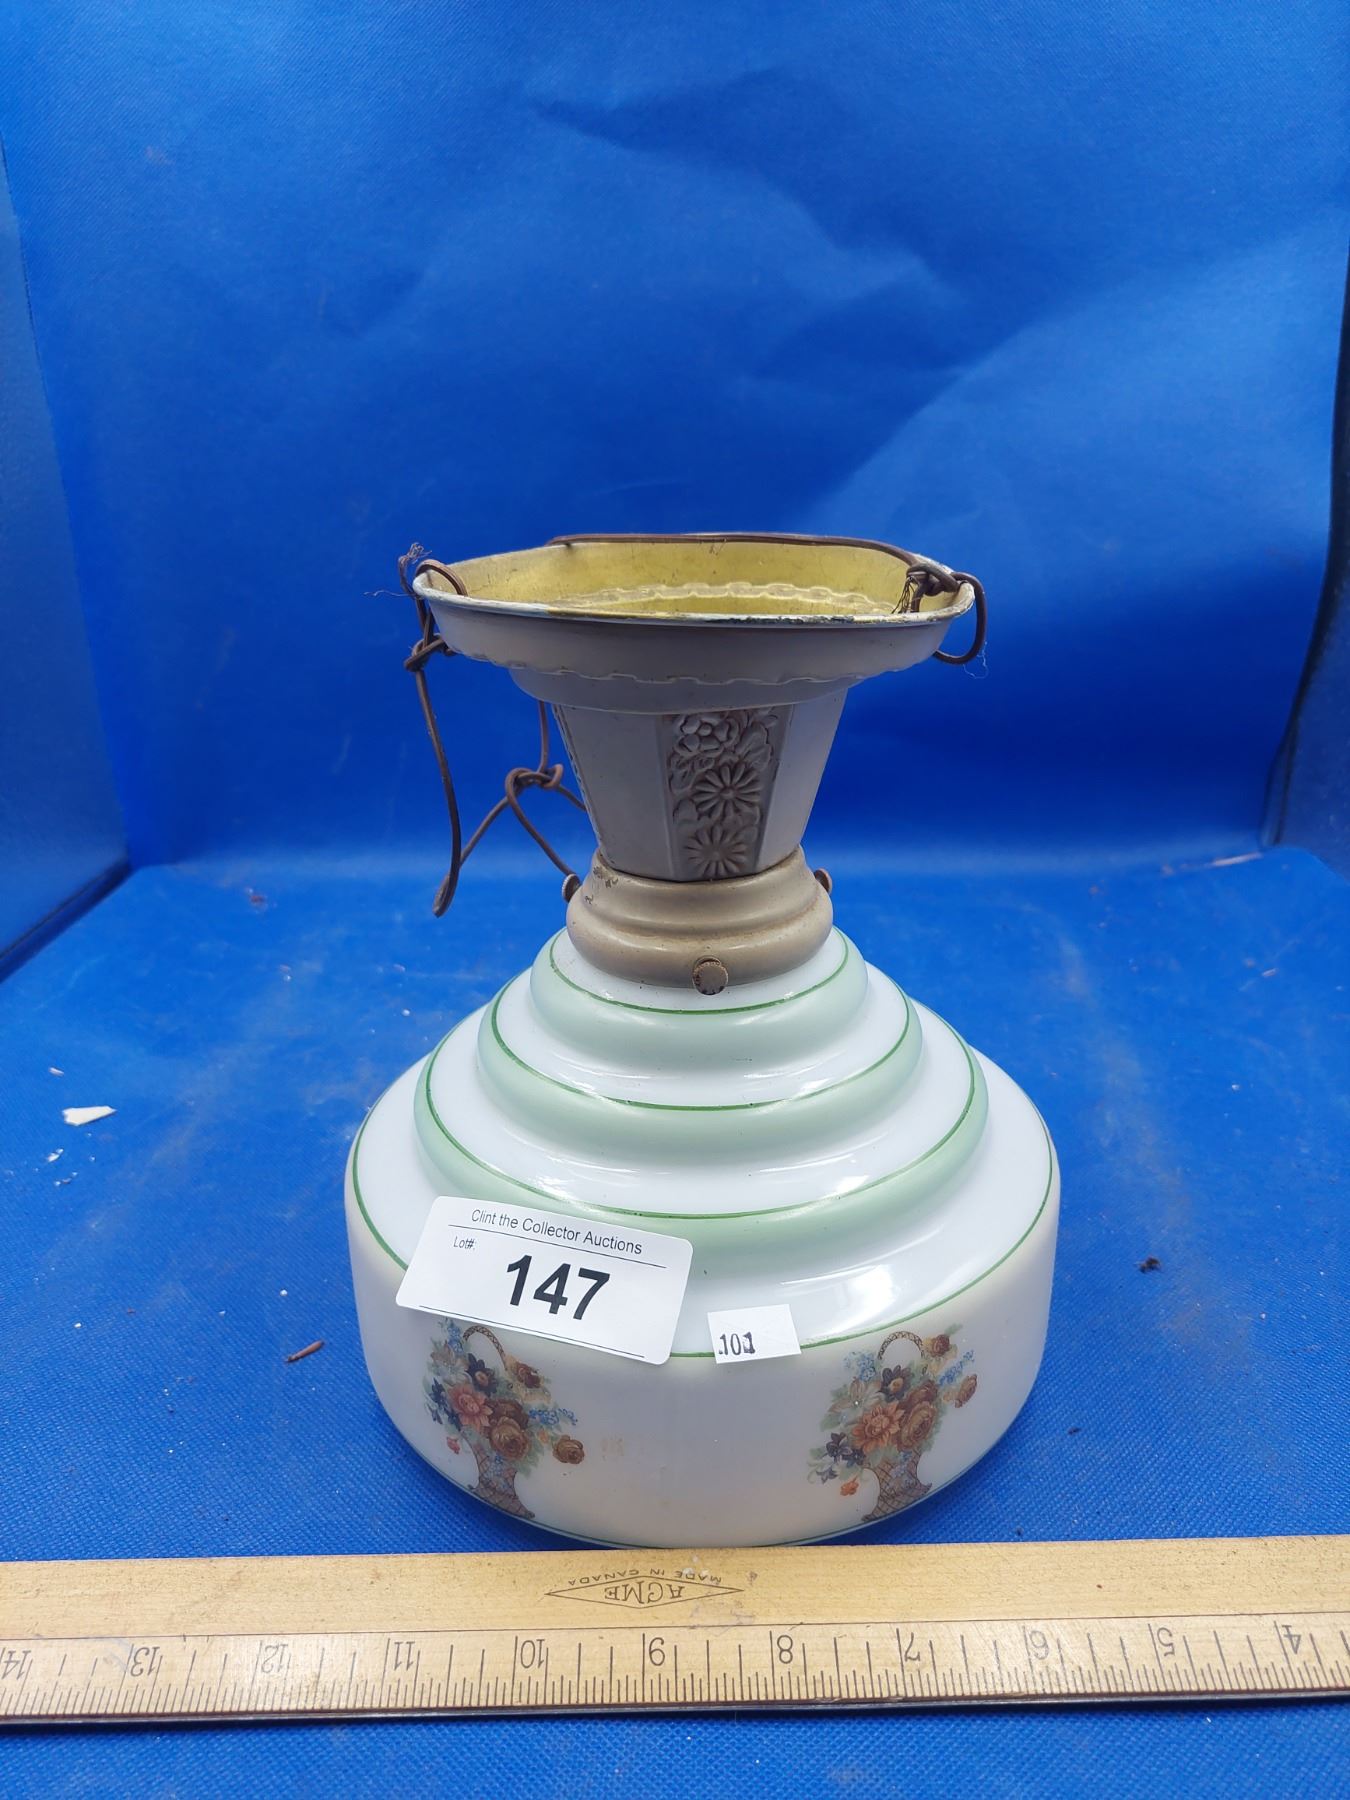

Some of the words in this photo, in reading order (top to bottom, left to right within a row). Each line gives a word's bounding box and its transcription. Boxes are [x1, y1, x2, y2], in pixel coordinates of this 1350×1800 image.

[471, 1209, 497, 1226] Clint
[498, 1213, 519, 1230] the
[522, 1218, 581, 1243] Collector
[583, 1231, 643, 1256] Auctions
[506, 1254, 610, 1321] 147
[568, 1570, 640, 1586] CANADA
[650, 1568, 665, 1576] IN
[675, 1570, 722, 1584] MADE
[604, 1580, 685, 1604] ACME
[519, 1638, 546, 1670] 10
[648, 1636, 666, 1666] 9
[776, 1634, 794, 1665] 8
[904, 1632, 921, 1662] 7
[1029, 1630, 1050, 1661] 6
[1157, 1627, 1176, 1657] 5
[1282, 1624, 1301, 1656] 4
[1, 1650, 32, 1681] 14
[130, 1646, 161, 1677] 13
[261, 1643, 289, 1674] 12
[394, 1641, 416, 1671] 11
